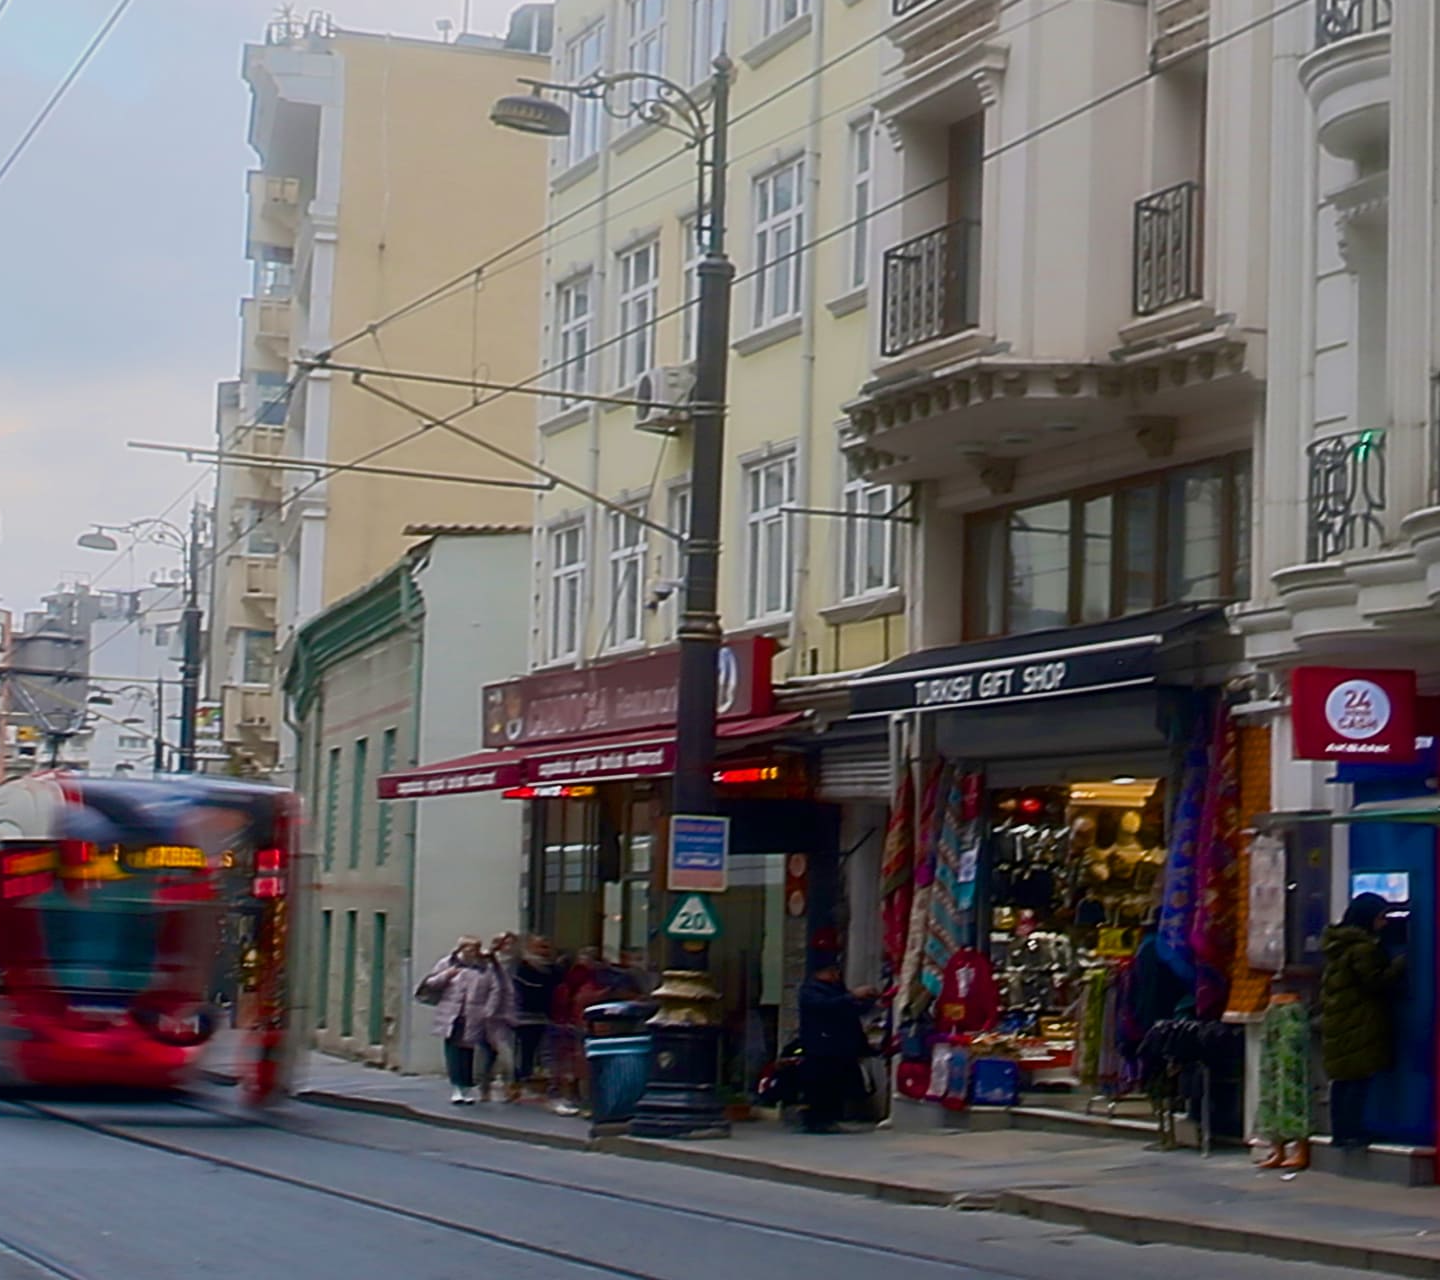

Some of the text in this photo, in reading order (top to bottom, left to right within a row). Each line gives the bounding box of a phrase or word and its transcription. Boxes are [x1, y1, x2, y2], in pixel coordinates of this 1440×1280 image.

[914, 661, 1067, 706] TURKISH GIFT SHOP
[1344, 689, 1373, 710] 24
[678, 911, 706, 930] 20
